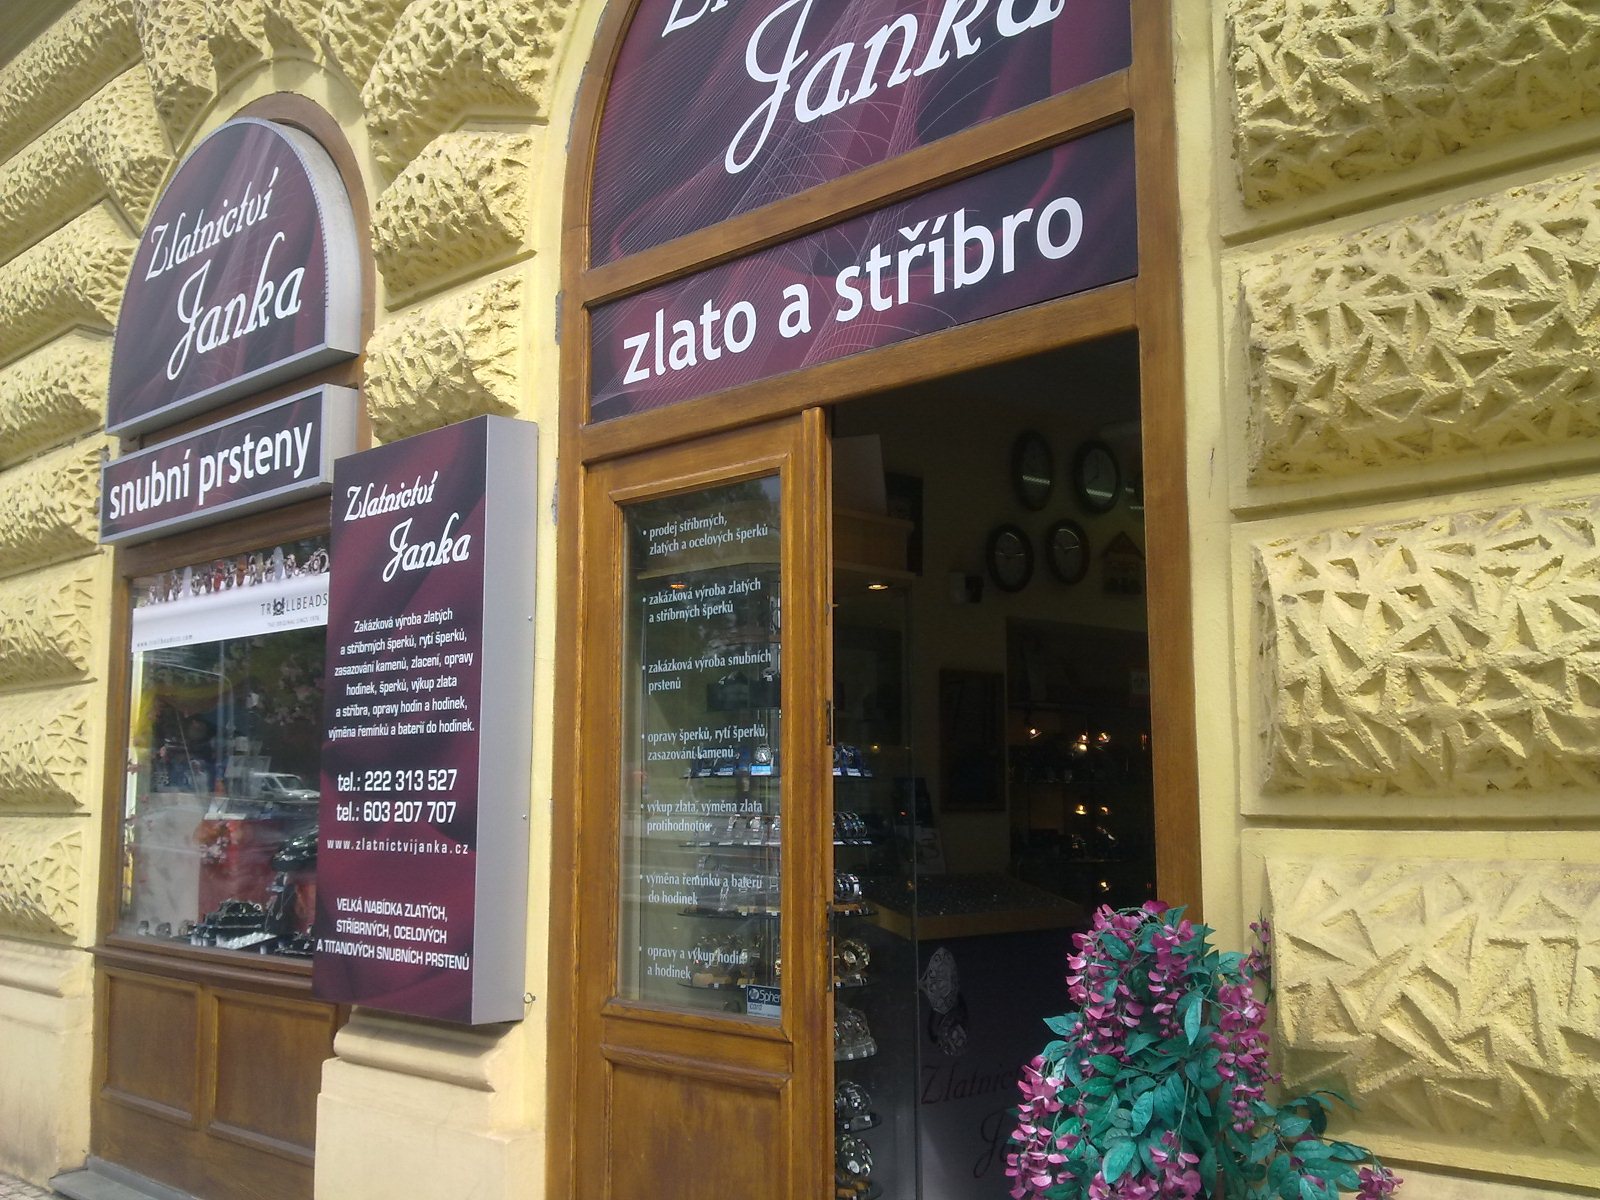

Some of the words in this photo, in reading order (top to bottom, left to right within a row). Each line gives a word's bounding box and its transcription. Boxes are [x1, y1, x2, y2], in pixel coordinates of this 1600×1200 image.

[145, 167, 279, 281] Zlatnictví
[623, 300, 756, 385] zlato
[778, 283, 811, 339] a
[835, 197, 1083, 322] stříbro
[167, 231, 306, 380] Janka
[109, 449, 190, 520] snubní
[198, 422, 313, 505] prsteny
[344, 470, 438, 522] Zlatnictví
[649, 521, 678, 541] prodej
[679, 512, 727, 532] stříbrných,
[382, 512, 472, 582] Janka
[649, 538, 679, 556] zlatých
[681, 540, 687, 550] a
[689, 529, 733, 548] ocelových
[735, 523, 768, 543] šperků
[648, 588, 693, 605] zakázková
[694, 584, 726, 601] výroba
[728, 577, 761, 596] zlatých
[354, 616, 393, 633] Zakázková
[396, 611, 421, 630] výroba
[423, 607, 453, 625] zlatých
[648, 613, 655, 623] a
[656, 603, 700, 622] stříbrných
[702, 601, 733, 619] šperků
[340, 645, 345, 656] a
[346, 637, 385, 655] stříbrných
[387, 633, 416, 652] šperků,
[419, 632, 434, 648] rytí
[435, 627, 467, 647] šperků,
[334, 661, 374, 677] zasazování
[375, 657, 408, 672] kamenů,
[411, 654, 441, 669] zlacení,
[444, 651, 474, 667] opravy
[648, 657, 693, 674] zakázková
[694, 655, 726, 672] výroba
[728, 649, 771, 664] snubních
[346, 680, 377, 696] hodinek,
[379, 680, 408, 696] šperků,
[411, 677, 435, 694] výkup
[436, 675, 457, 688] zlata
[648, 677, 681, 695] prstenů
[335, 708, 341, 718] a
[342, 704, 370, 717] stříbra,
[372, 703, 399, 718] opravy
[400, 699, 423, 713] hodin
[424, 702, 430, 712] a
[431, 696, 468, 711] hodinek,
[328, 726, 356, 742] výměna
[357, 723, 389, 737] řemínků
[390, 725, 396, 736] a
[398, 720, 425, 736] baterií
[426, 720, 437, 733] do
[438, 718, 474, 733] hodinek.
[647, 731, 678, 746] opravy
[679, 727, 713, 745] šperků,
[714, 725, 731, 744] rytí
[647, 747, 696, 761] zasazování
[337, 771, 361, 792] tel.:
[364, 770, 392, 792] 222
[395, 770, 424, 791] 313
[427, 769, 458, 791] 527
[336, 801, 360, 822] tel.:
[363, 801, 391, 822] 603
[394, 801, 423, 823] 207
[427, 801, 457, 823] 707
[647, 799, 673, 817] výkup
[701, 800, 737, 816] výměna
[740, 798, 763, 813] zlata
[326, 837, 469, 856] www.zlatnictvijanka.cz
[646, 872, 680, 887] výměna
[722, 878, 729, 888] a
[336, 897, 363, 913] VELKÁ
[364, 899, 403, 917] NABÍDKA
[404, 903, 448, 923] ZLATÝCH,
[648, 890, 660, 903] do
[662, 890, 698, 905] hodinek
[336, 917, 391, 940] STŘÍBRNÝCH,
[393, 925, 447, 944] OCELOVÝCH
[316, 938, 323, 952] A
[324, 939, 374, 959] TITANOVÝCH
[376, 946, 423, 965] SNUBNÍCH
[425, 952, 470, 971] PRSTENŮ
[647, 946, 678, 961] opravy
[679, 949, 686, 959] a
[647, 965, 653, 976] a
[654, 963, 691, 980] hodinek
[759, 990, 782, 1003] Spher
[920, 1064, 1015, 1105] Zlatnic
